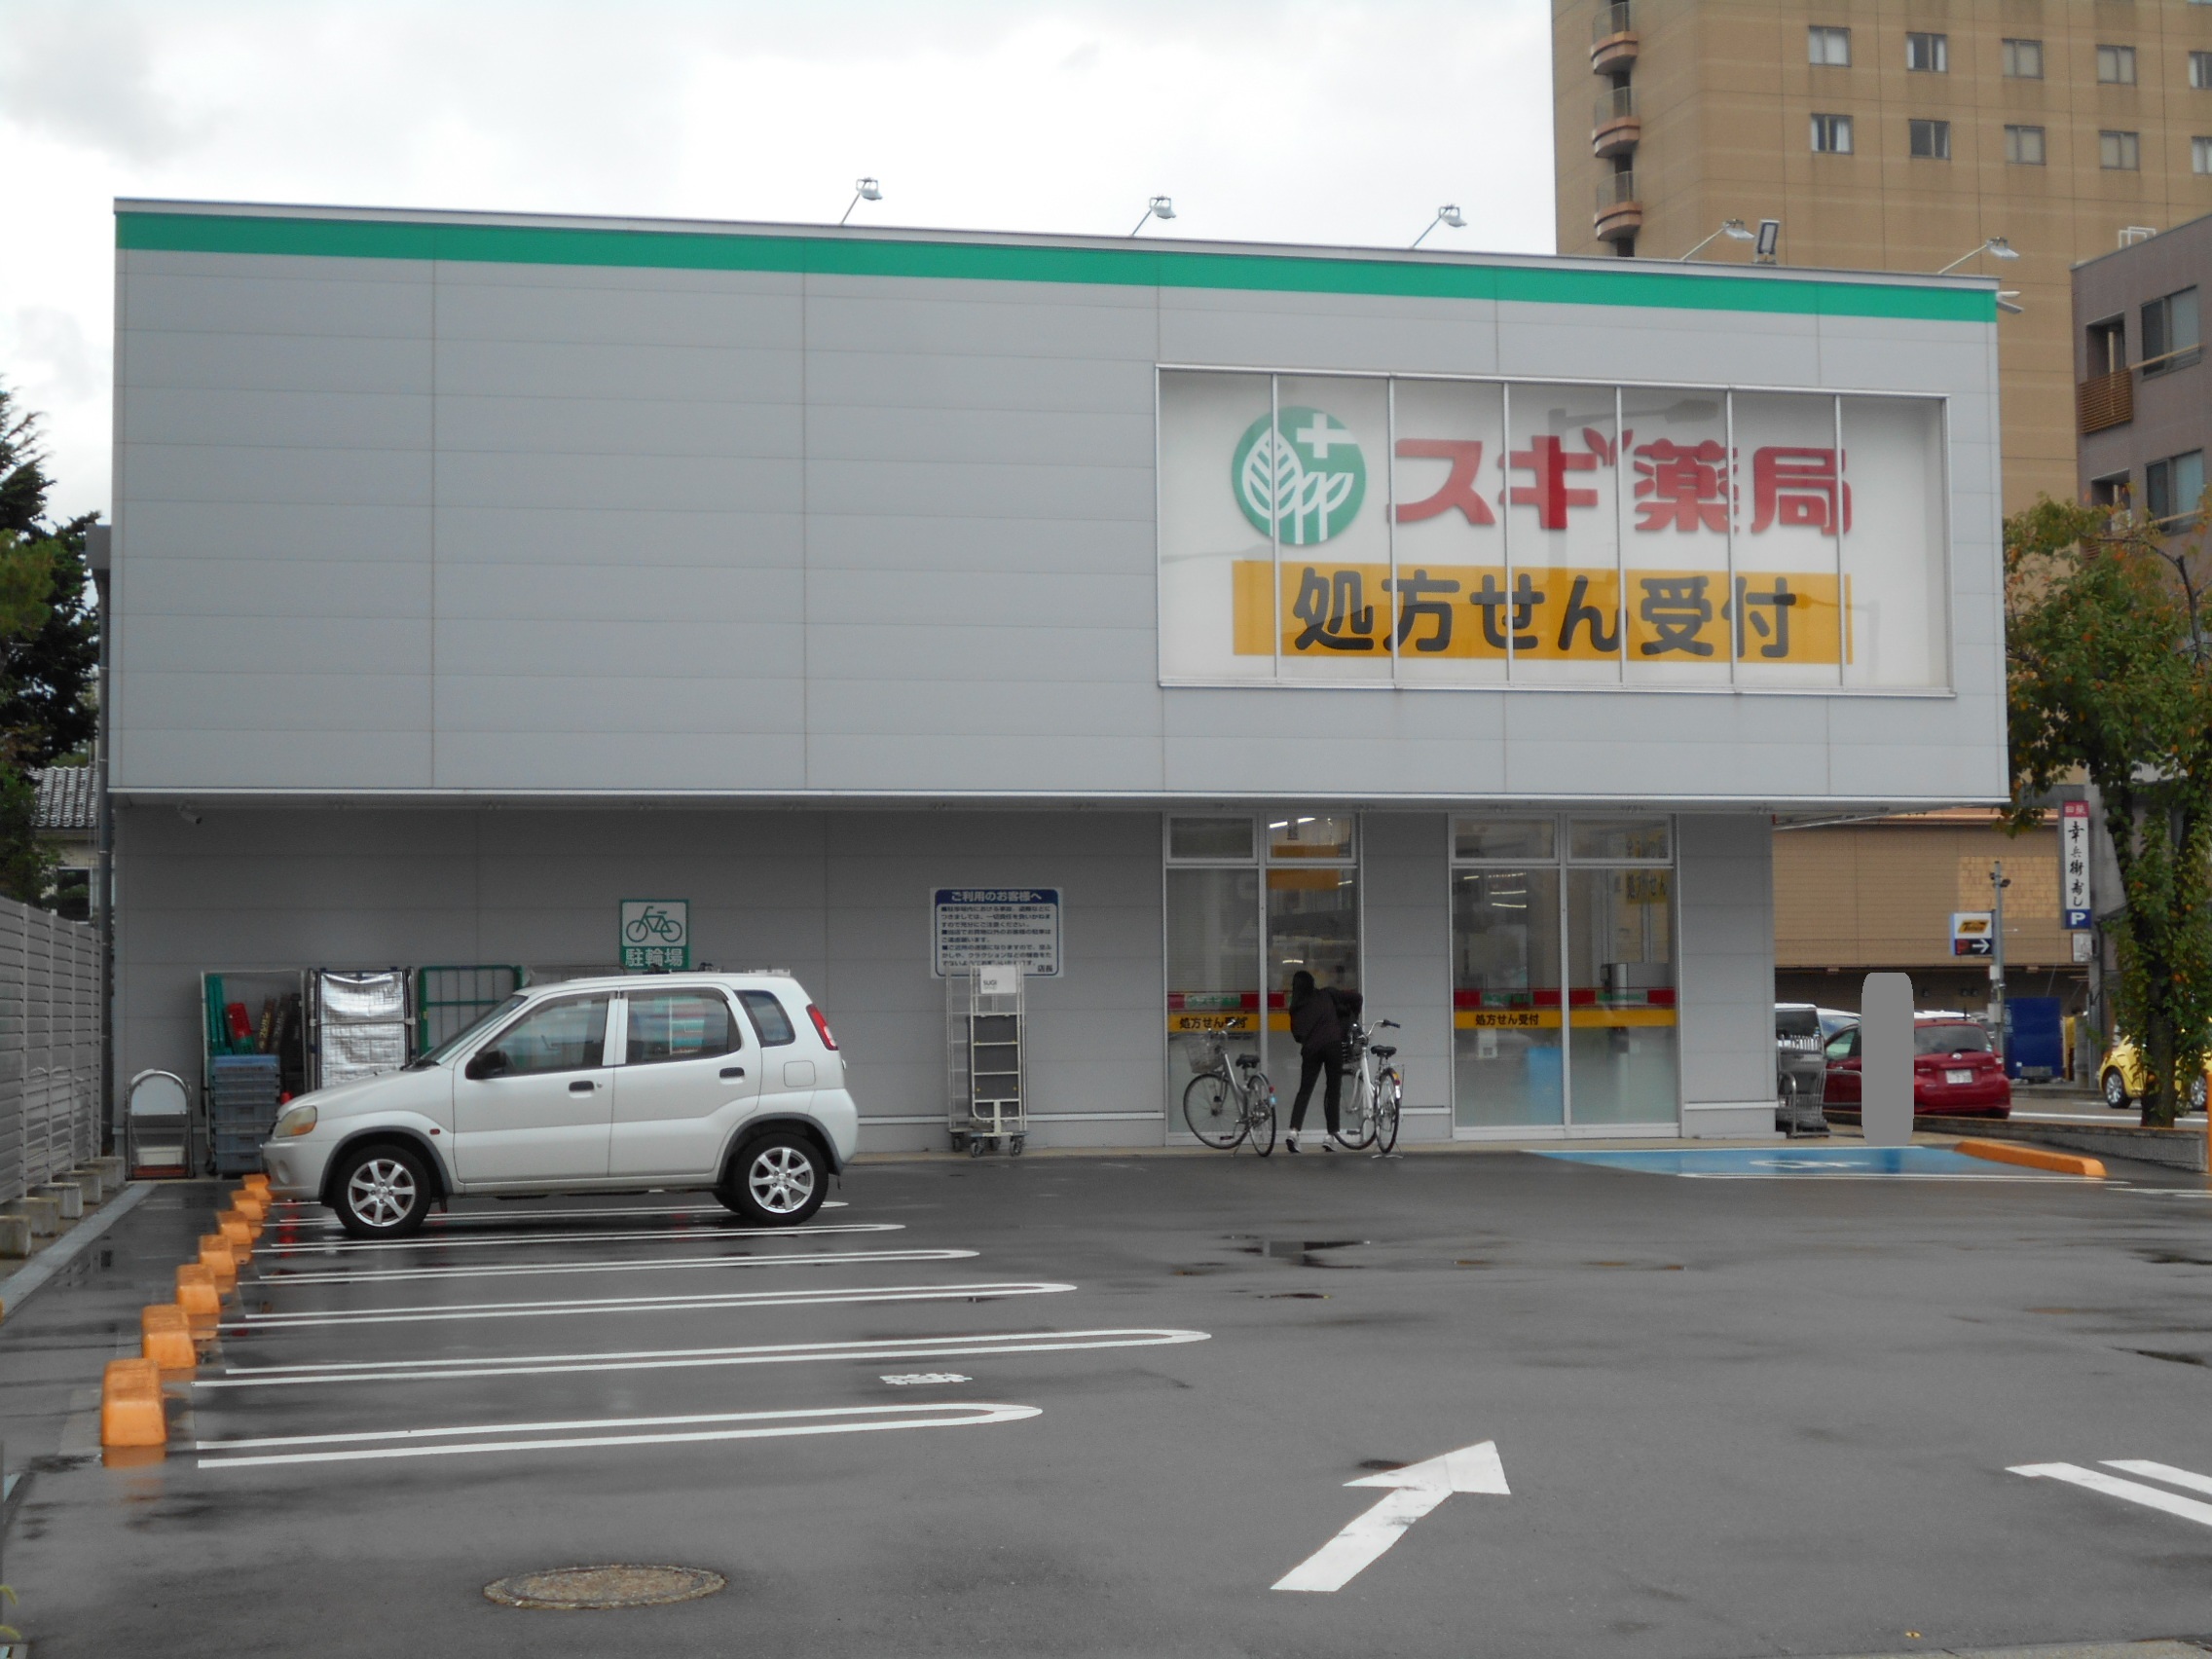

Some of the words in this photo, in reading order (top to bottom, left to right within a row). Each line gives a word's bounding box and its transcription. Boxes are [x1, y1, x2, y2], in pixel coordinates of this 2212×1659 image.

[1388, 427, 1853, 536] スギ薬局
[1292, 566, 1797, 659] 処方せん受付
[951, 891, 1043, 903] ご利用のお客様へ
[2071, 912, 2086, 925] P
[625, 948, 683, 967] 駐輪場
[1475, 1014, 1539, 1026] 処方せん受付
